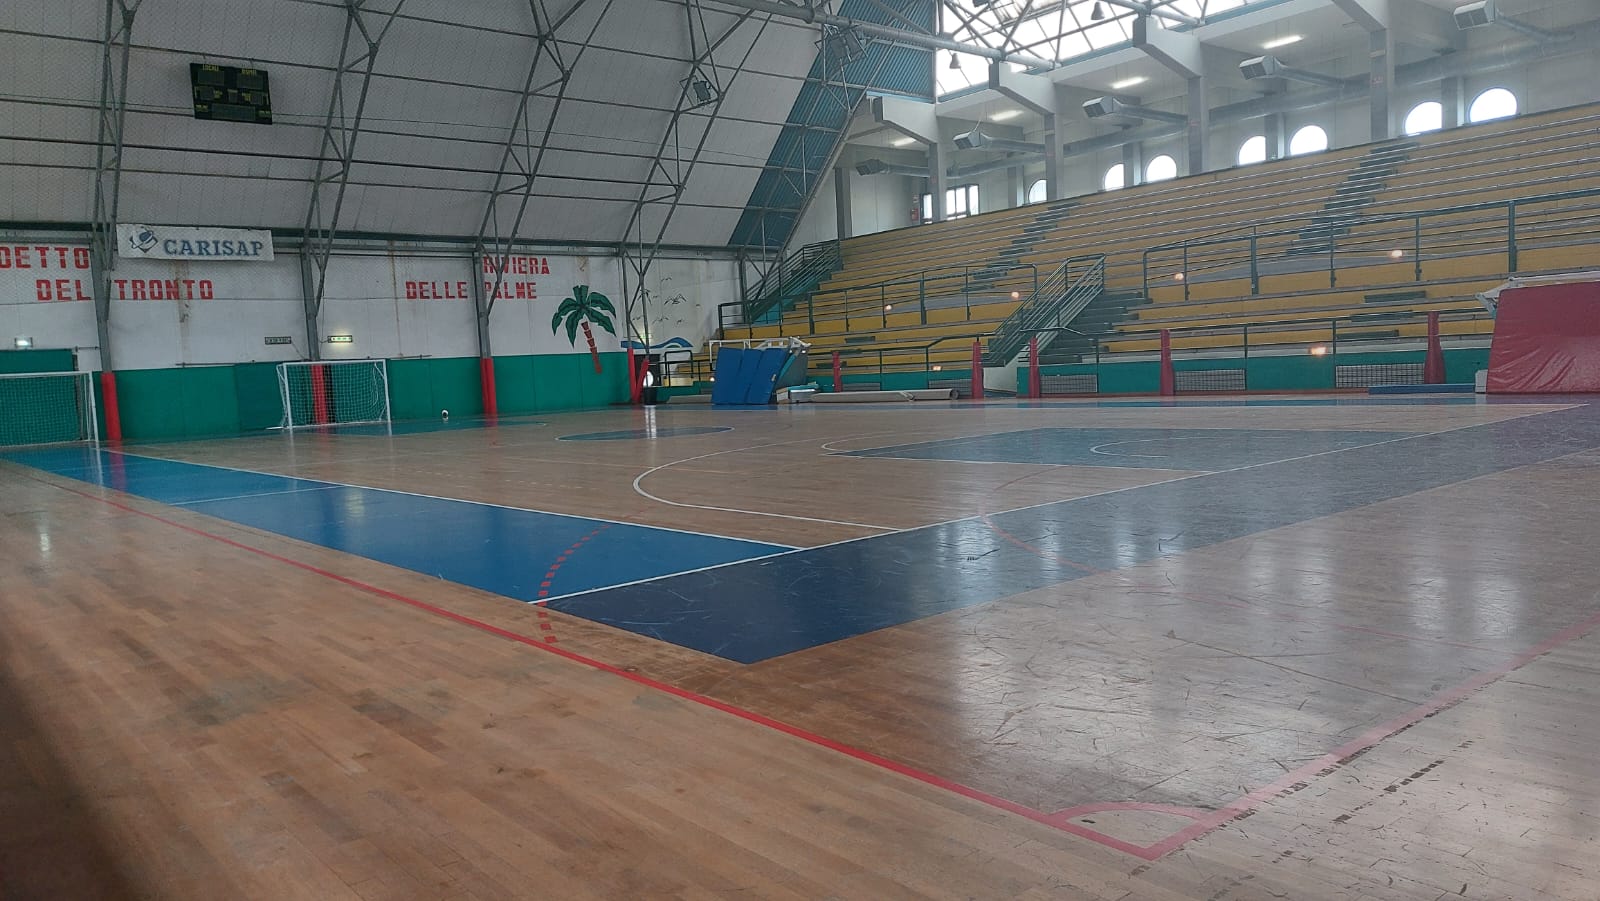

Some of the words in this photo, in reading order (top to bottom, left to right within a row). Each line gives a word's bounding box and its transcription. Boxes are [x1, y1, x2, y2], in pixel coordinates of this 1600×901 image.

[163, 239, 264, 256] CARISAP
[36, 279, 92, 301] DEL
[114, 279, 214, 300] TRONTO
[405, 281, 468, 299] DELLE
